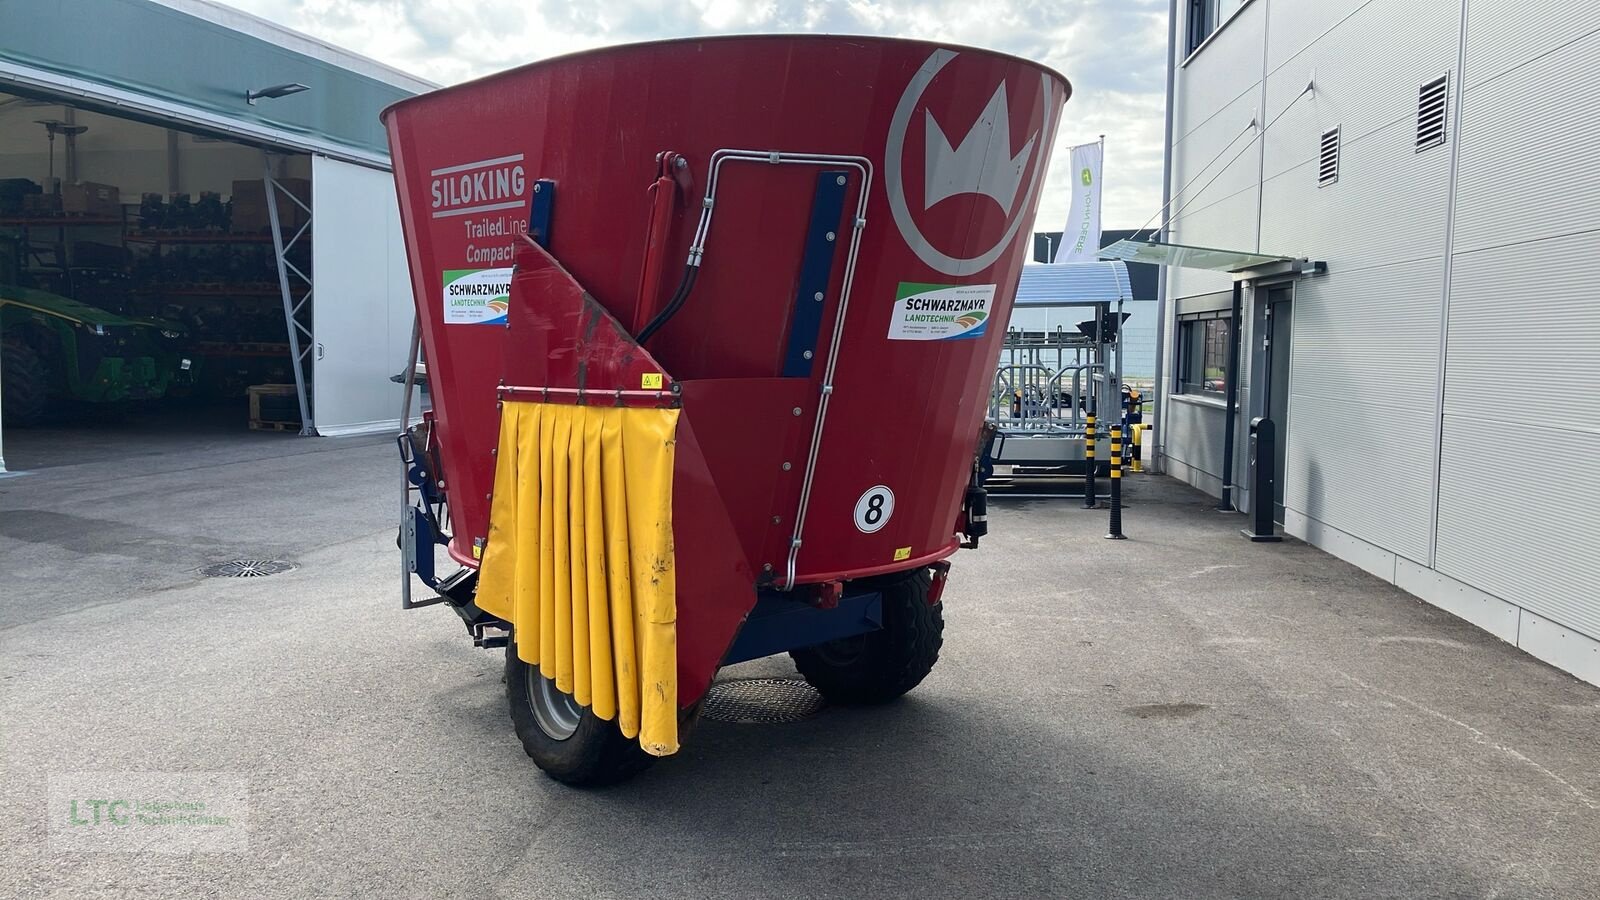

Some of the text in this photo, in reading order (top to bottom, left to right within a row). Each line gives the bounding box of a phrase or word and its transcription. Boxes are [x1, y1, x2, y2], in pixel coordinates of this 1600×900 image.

[431, 165, 525, 208] SILOKING
[464, 215, 527, 239] TrailedLine
[466, 242, 515, 267] Compact
[449, 283, 511, 296] SCHWARZMAYR
[450, 299, 486, 307] LANDTECHNIK
[905, 298, 985, 311] SCHWARZMAYR
[904, 314, 956, 323] LANDTECHNIK
[864, 493, 885, 525] 8
